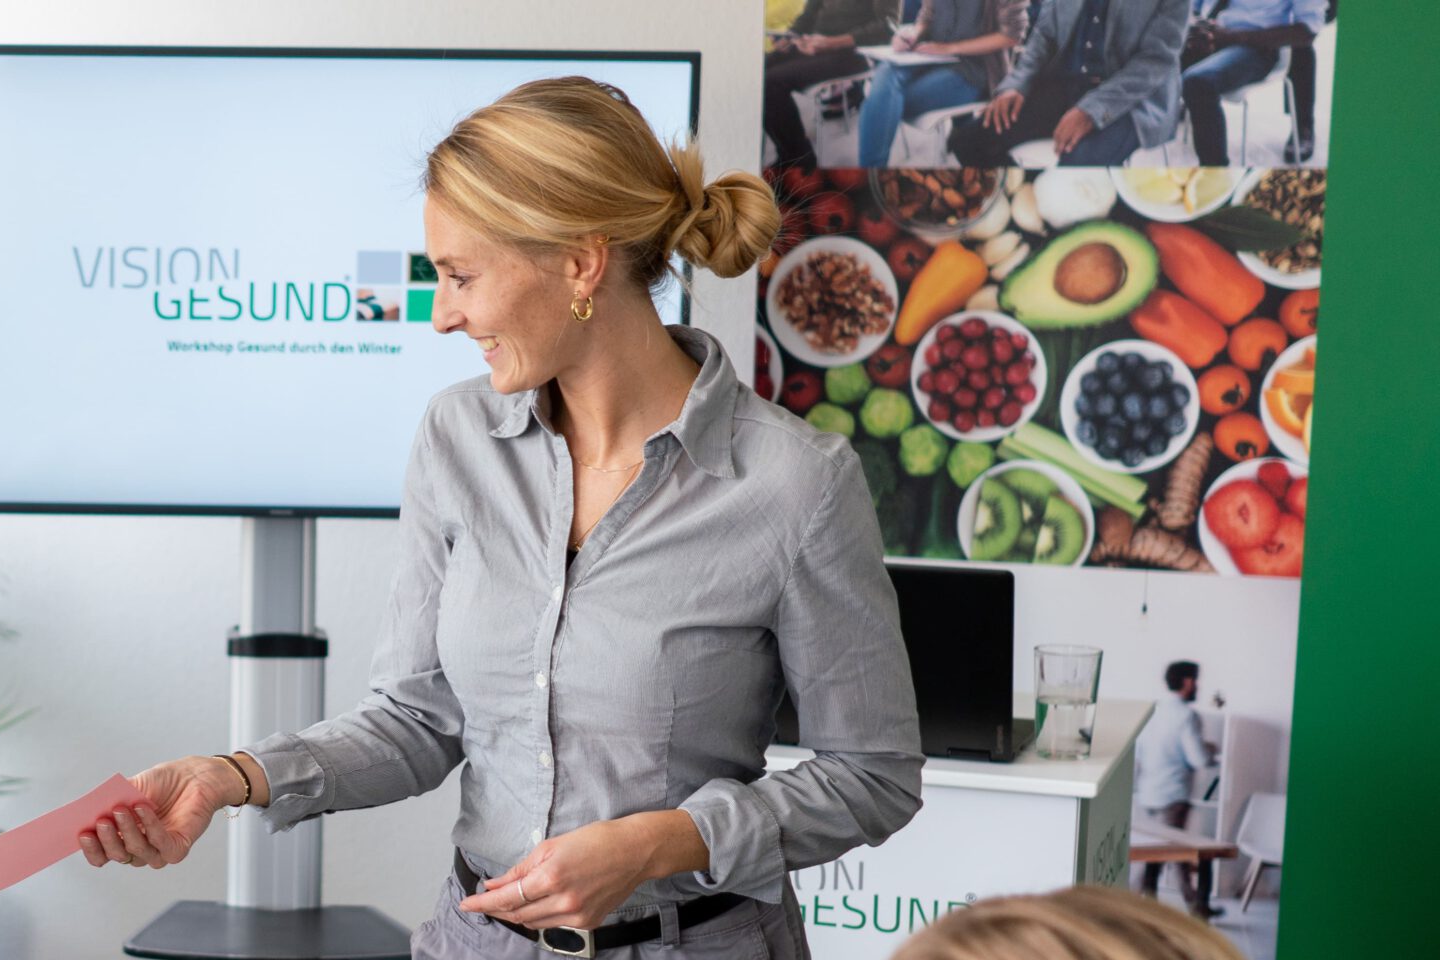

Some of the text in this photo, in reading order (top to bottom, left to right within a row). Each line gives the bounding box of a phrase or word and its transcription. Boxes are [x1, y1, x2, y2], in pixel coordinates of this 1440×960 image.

[72, 247, 240, 289] VISION
[167, 341, 402, 355] Workshop Gesund durch den Winter
